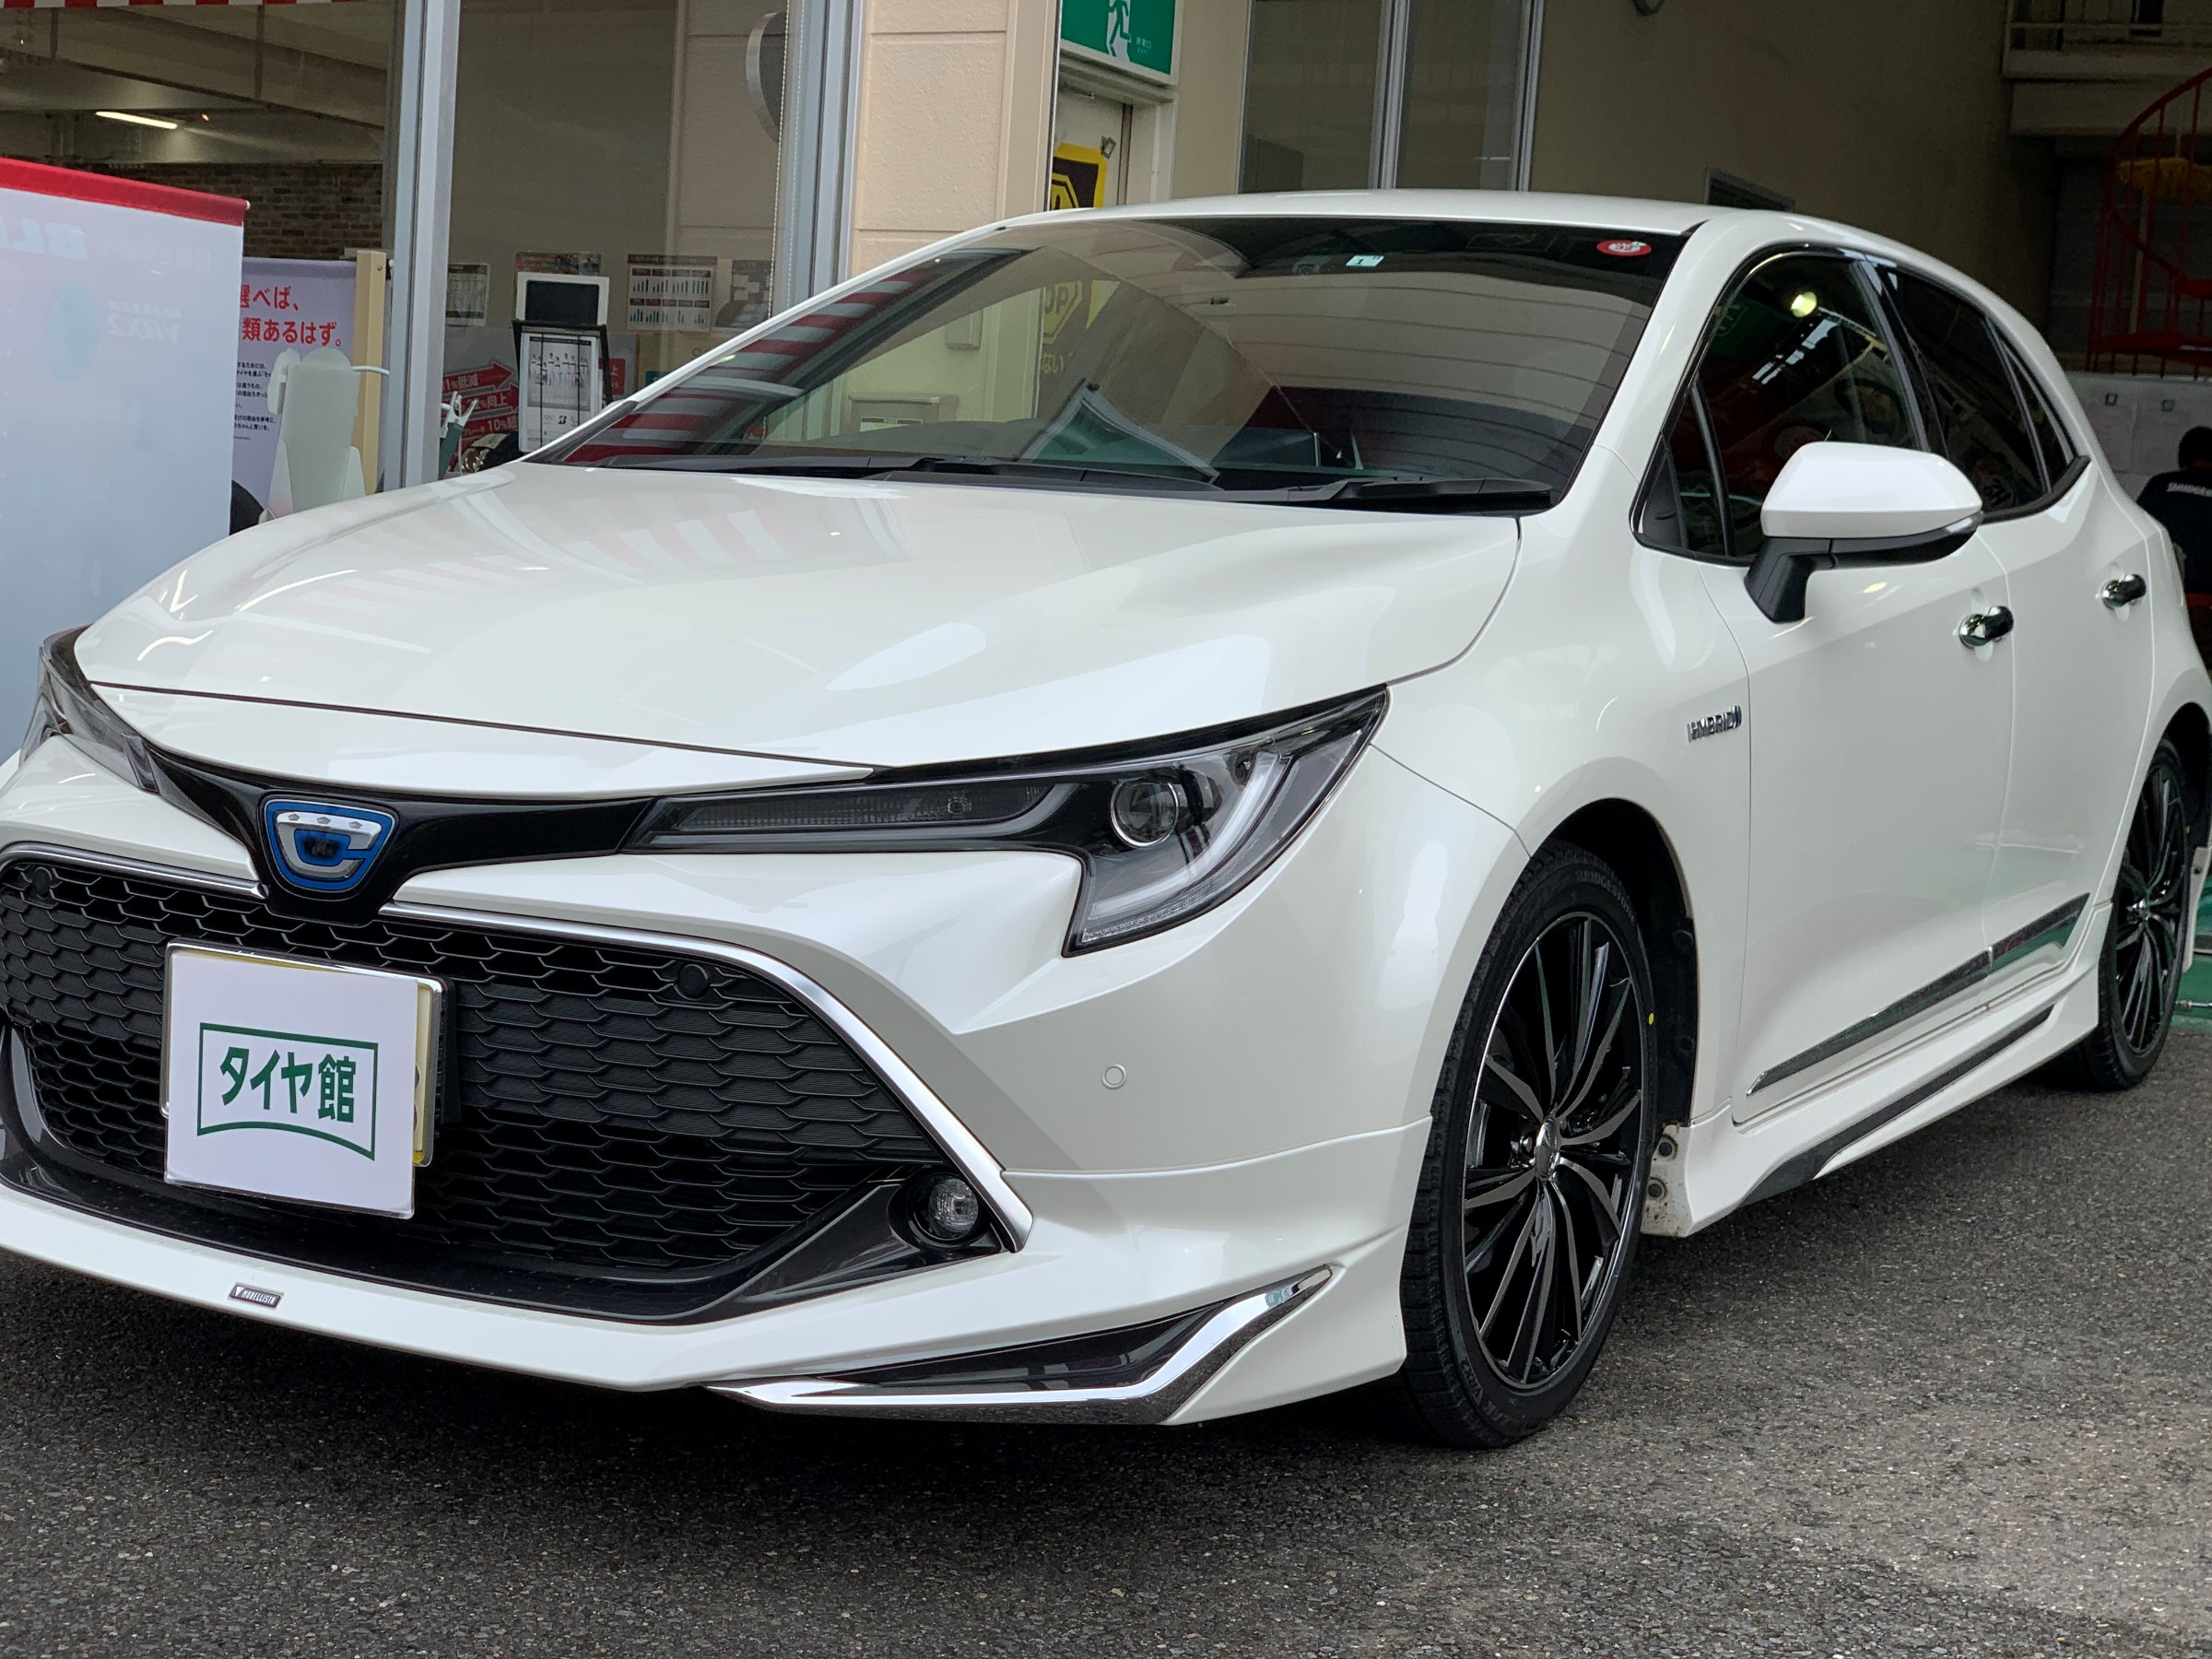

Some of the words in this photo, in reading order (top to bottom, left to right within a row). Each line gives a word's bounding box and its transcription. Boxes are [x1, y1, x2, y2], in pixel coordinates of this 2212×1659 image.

[241, 316, 342, 347] 類あるはず。
[219, 1046, 357, 1124] タイヤ館
